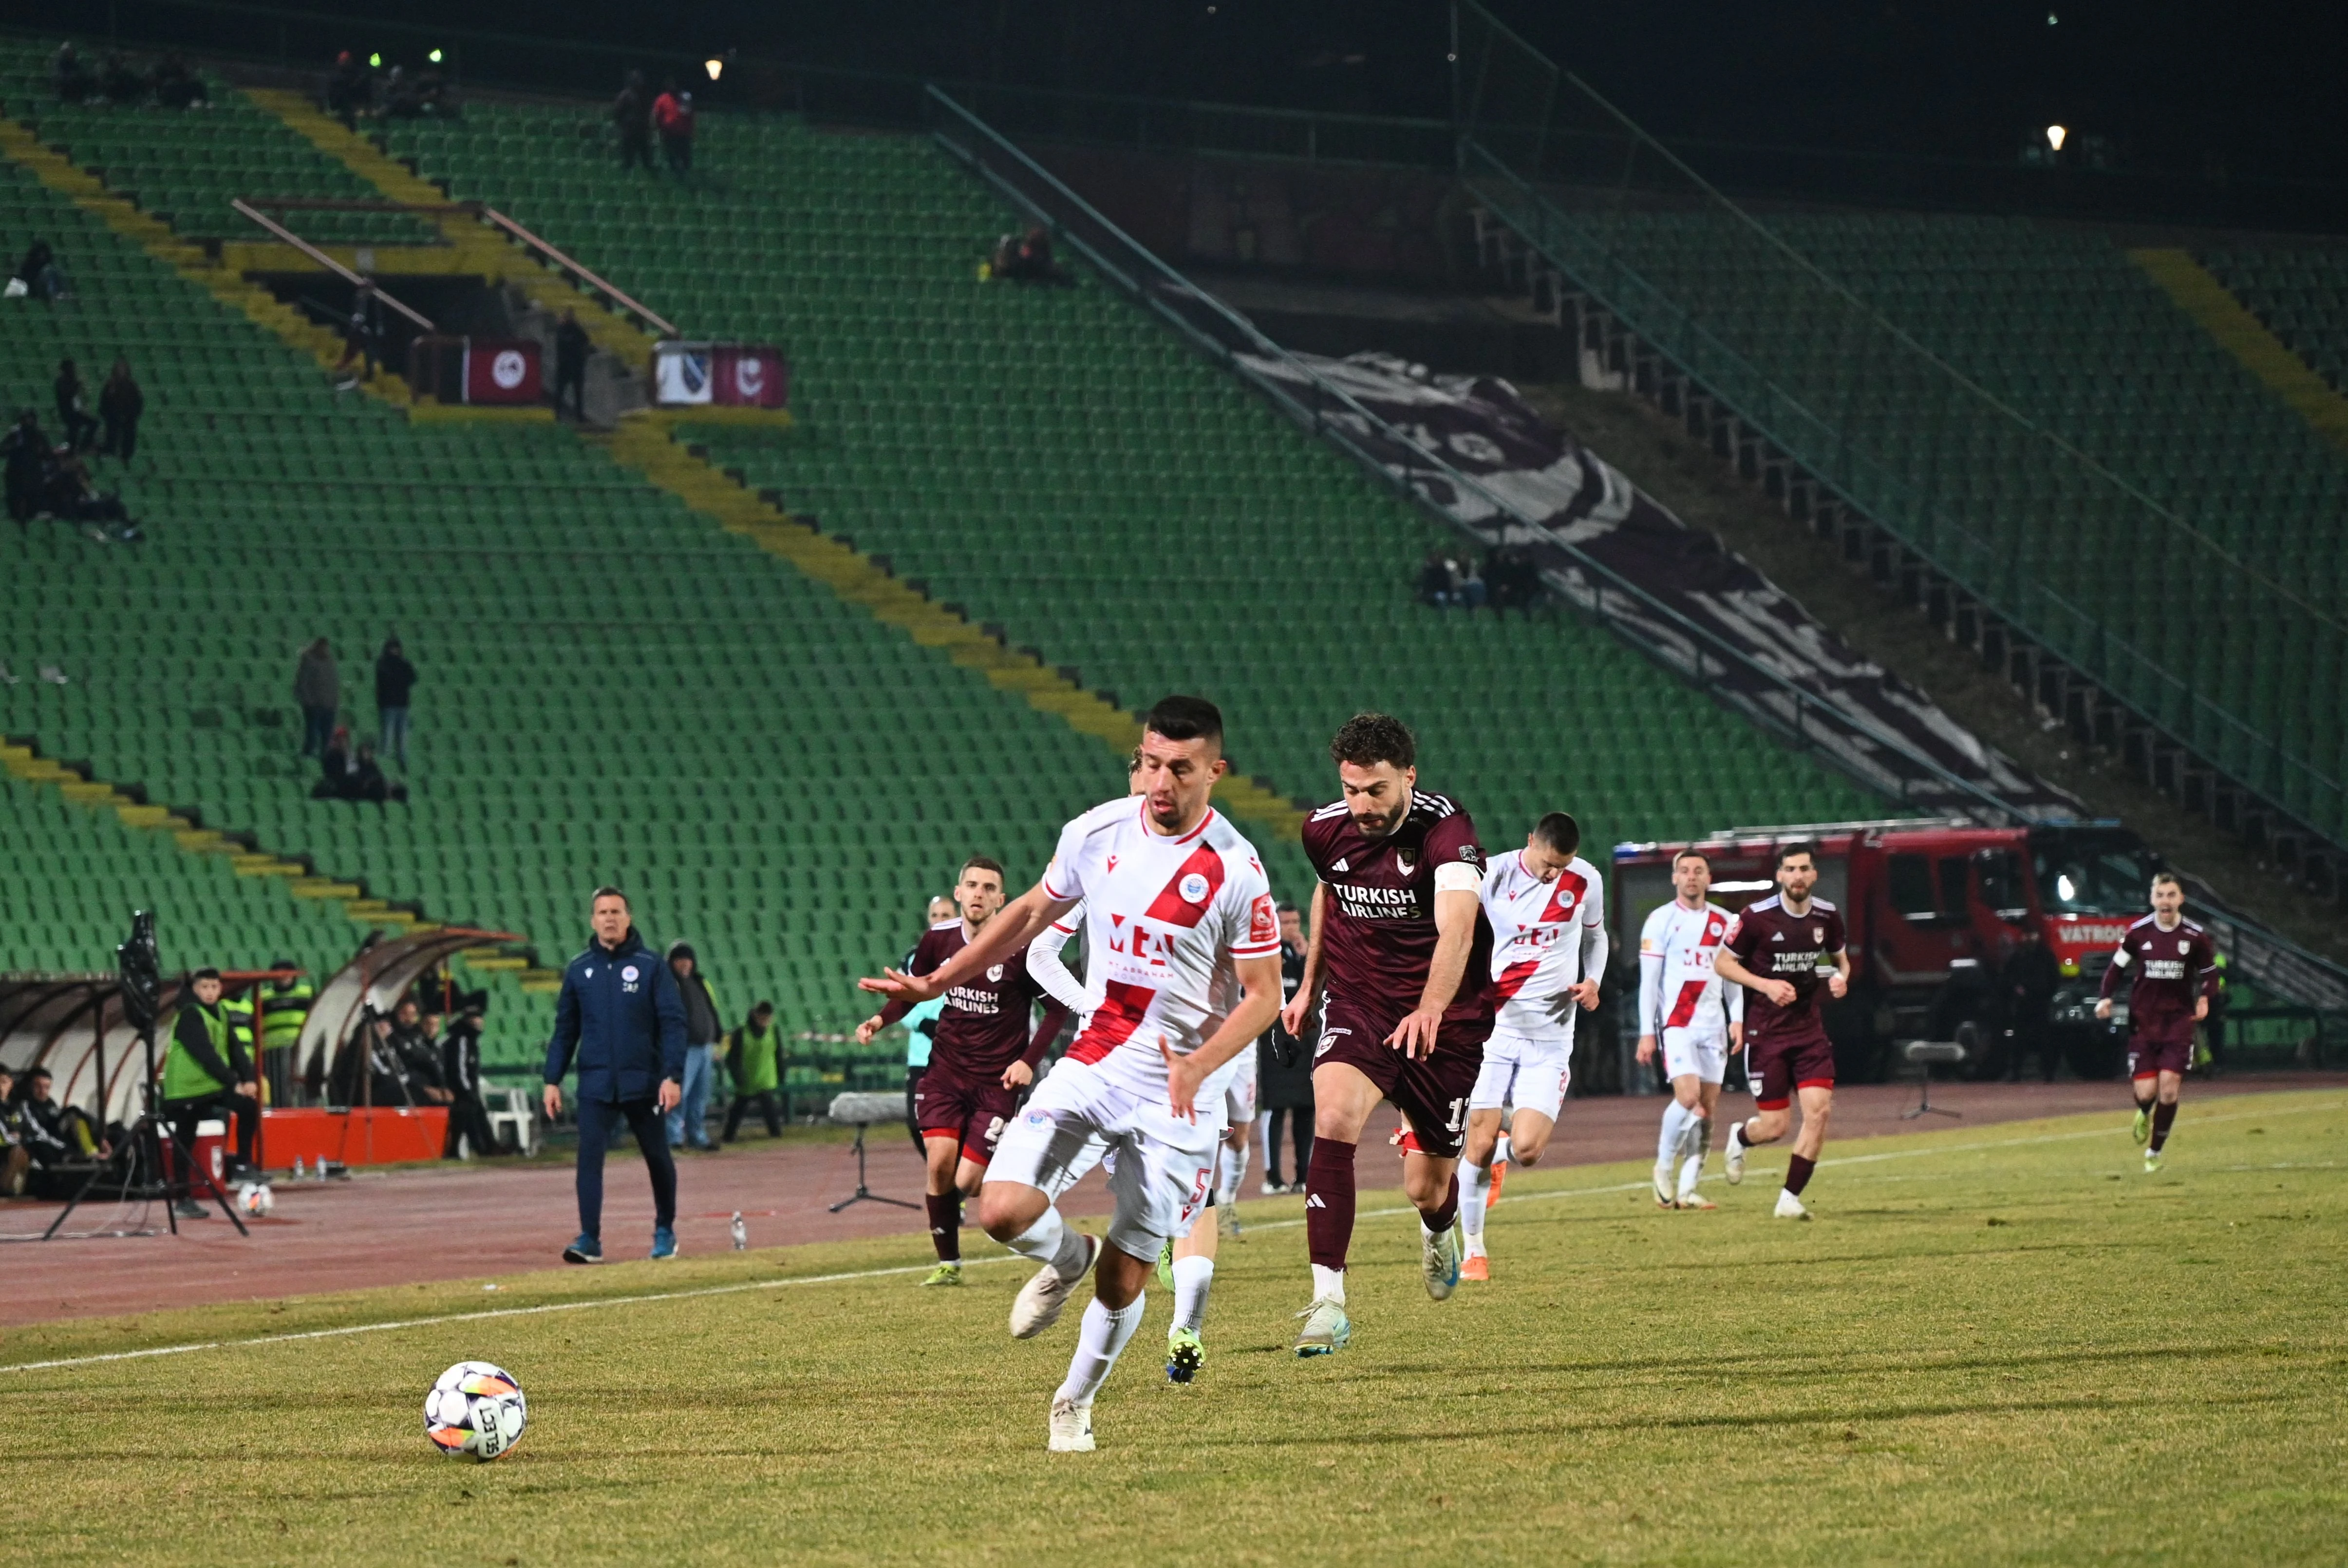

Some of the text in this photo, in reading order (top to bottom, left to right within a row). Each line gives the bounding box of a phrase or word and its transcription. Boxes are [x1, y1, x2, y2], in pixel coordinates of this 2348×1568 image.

[1333, 883, 1416, 905] TURKISH
[1341, 900, 1422, 919] AIRLINES
[1122, 966, 1174, 978] ABRAHAM
[946, 986, 998, 1002] URKISH
[944, 995, 999, 1013] AIRLINES
[1189, 1168, 1212, 1204] 5
[479, 1407, 500, 1455] SELECT
